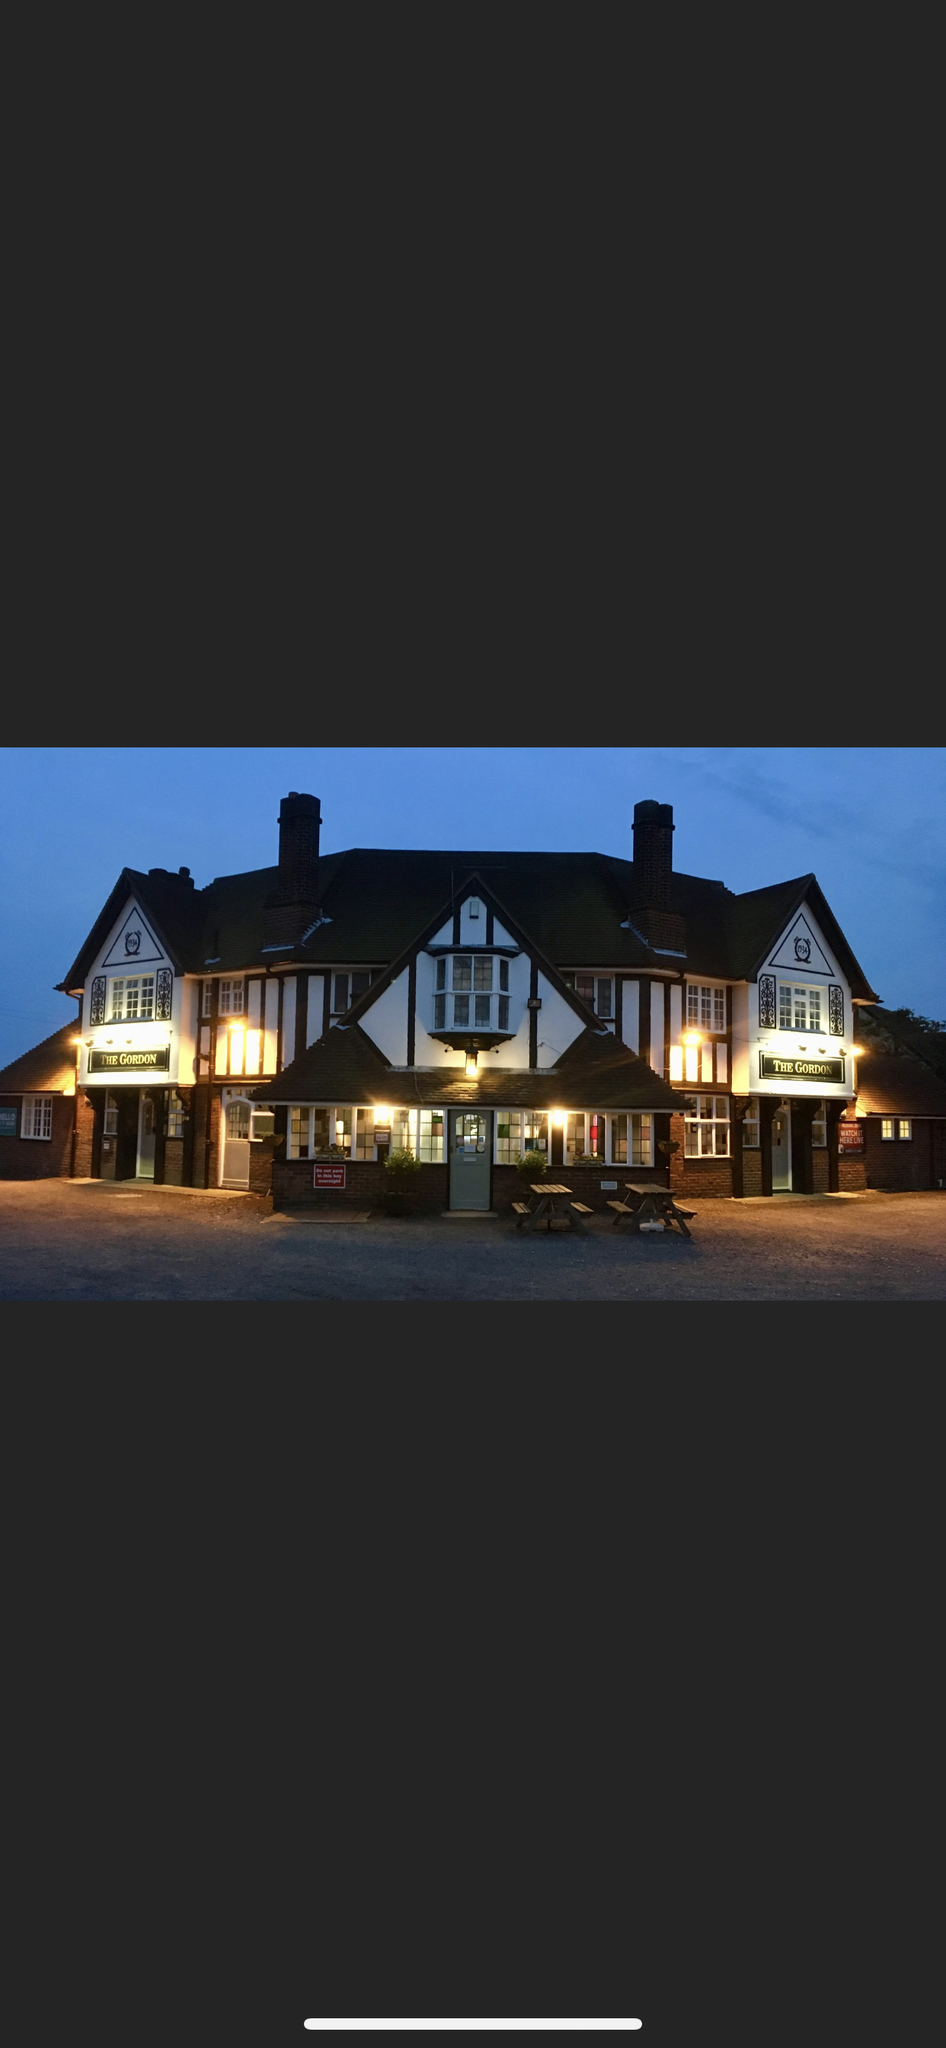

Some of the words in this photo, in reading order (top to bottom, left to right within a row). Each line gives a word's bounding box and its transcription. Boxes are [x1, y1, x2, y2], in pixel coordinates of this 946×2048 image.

[101, 1054, 118, 1065] THE
[119, 1053, 157, 1065] GORDON
[773, 1060, 793, 1072] THE
[795, 1061, 832, 1074] GORDON
[840, 1136, 853, 1144] HERE
[853, 1136, 864, 1144] LIVE
